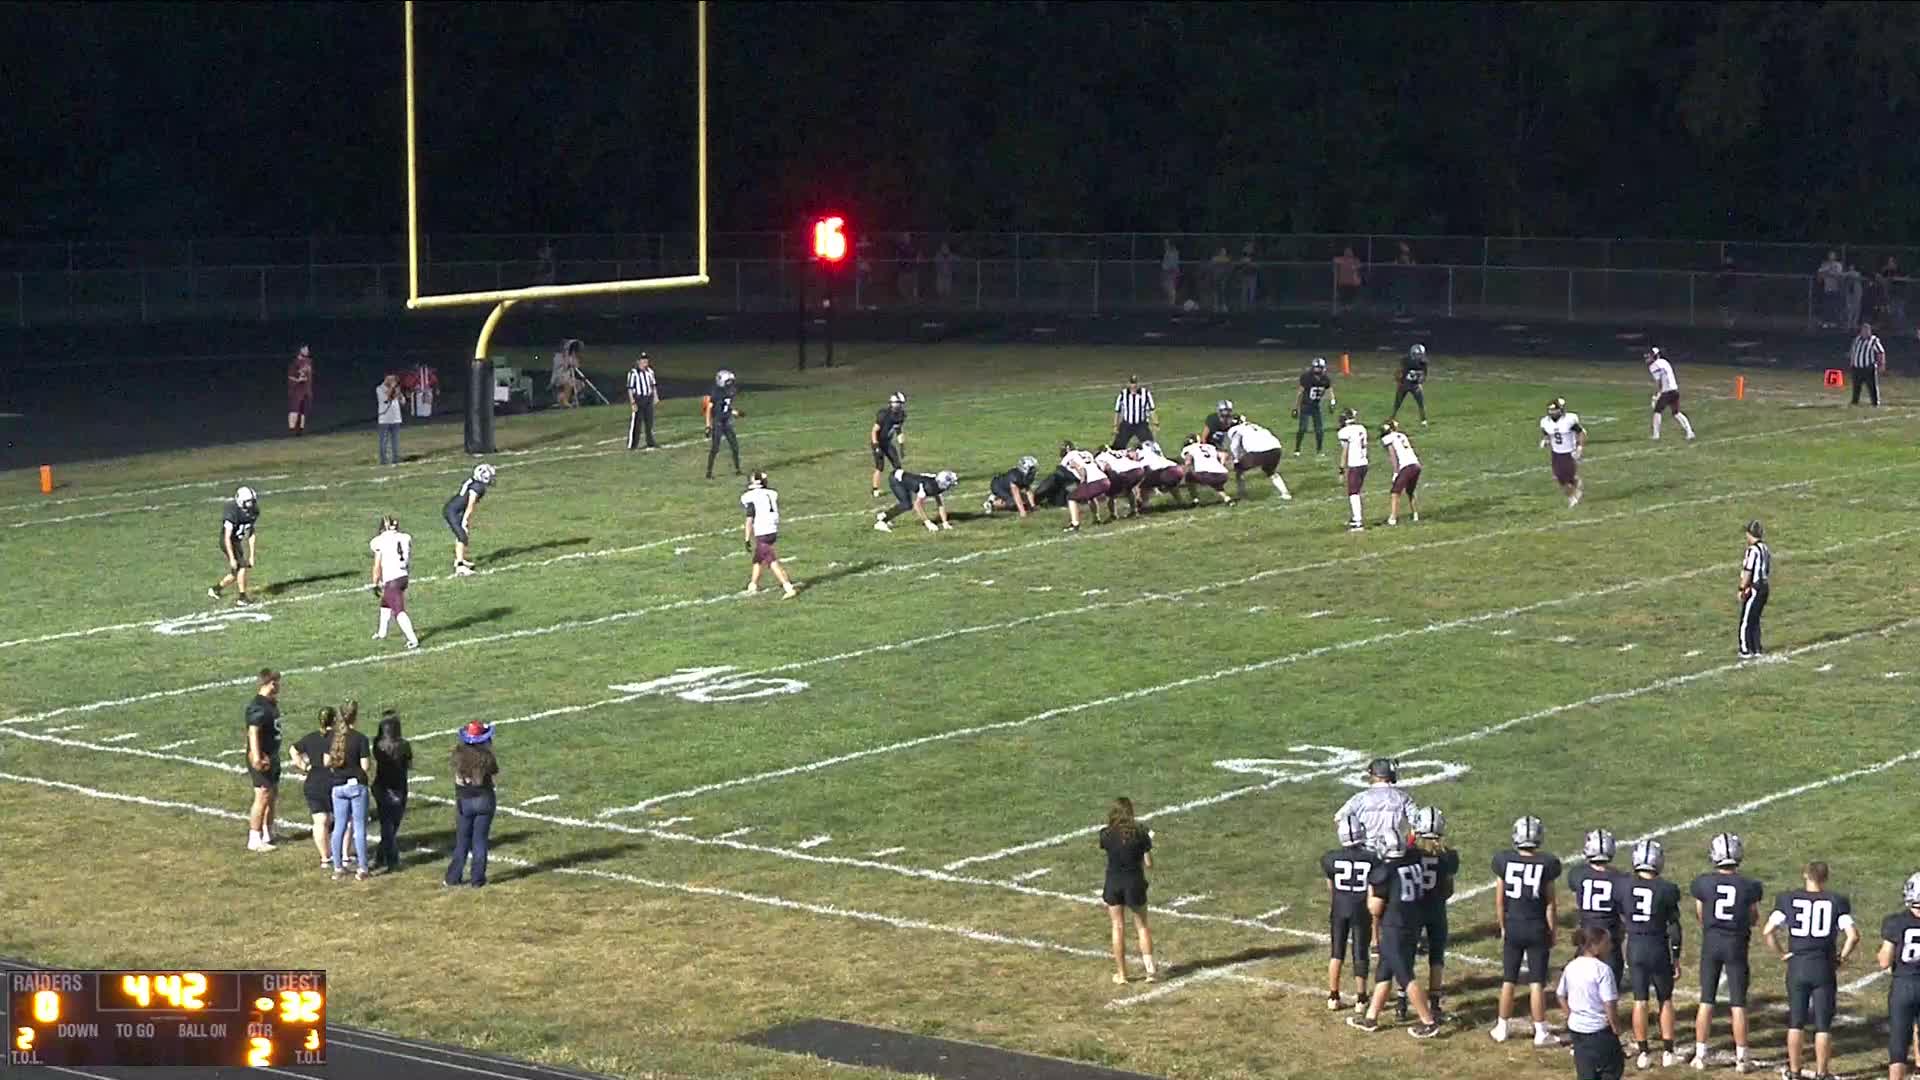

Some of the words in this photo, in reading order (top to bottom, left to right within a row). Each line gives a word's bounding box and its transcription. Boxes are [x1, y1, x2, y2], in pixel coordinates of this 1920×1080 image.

[814, 216, 846, 259] 16
[1212, 744, 1470, 788] 20
[1334, 860, 1372, 892] 23
[1505, 862, 1544, 898] 54
[1582, 879, 1613, 912] 12
[1632, 887, 1653, 922] 3
[1714, 885, 1736, 920] 2
[1791, 899, 1833, 937] 30
